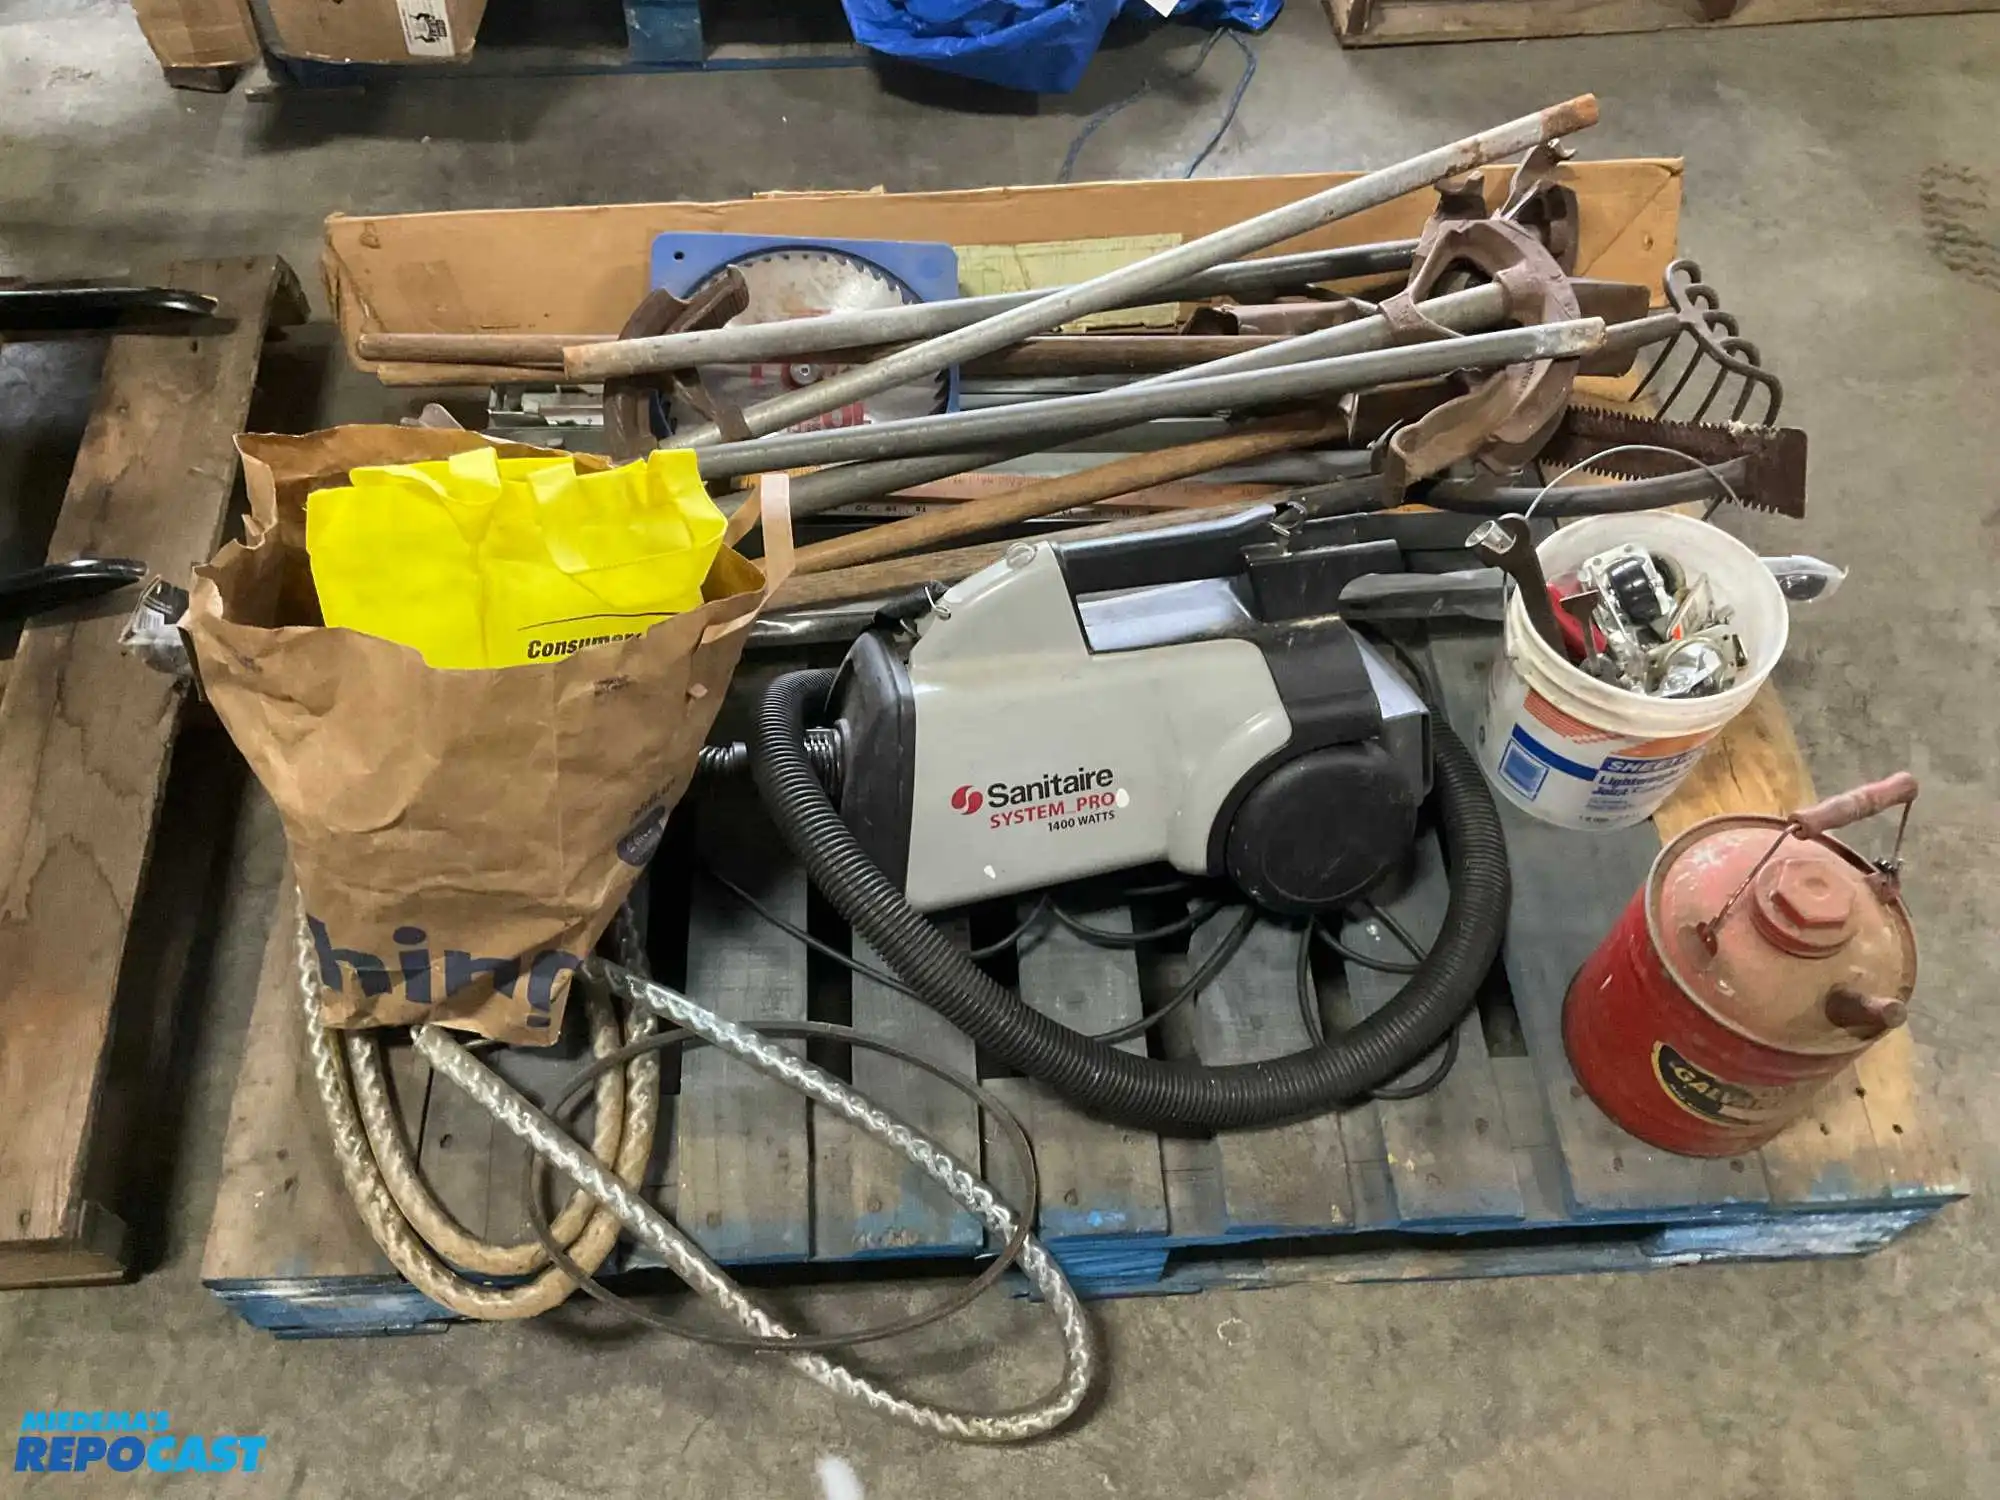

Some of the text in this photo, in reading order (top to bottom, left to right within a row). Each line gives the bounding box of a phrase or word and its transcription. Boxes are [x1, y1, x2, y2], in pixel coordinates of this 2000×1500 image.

[987, 767, 1113, 808] Sanitaire
[1048, 810, 1116, 833] 1400 WATTS
